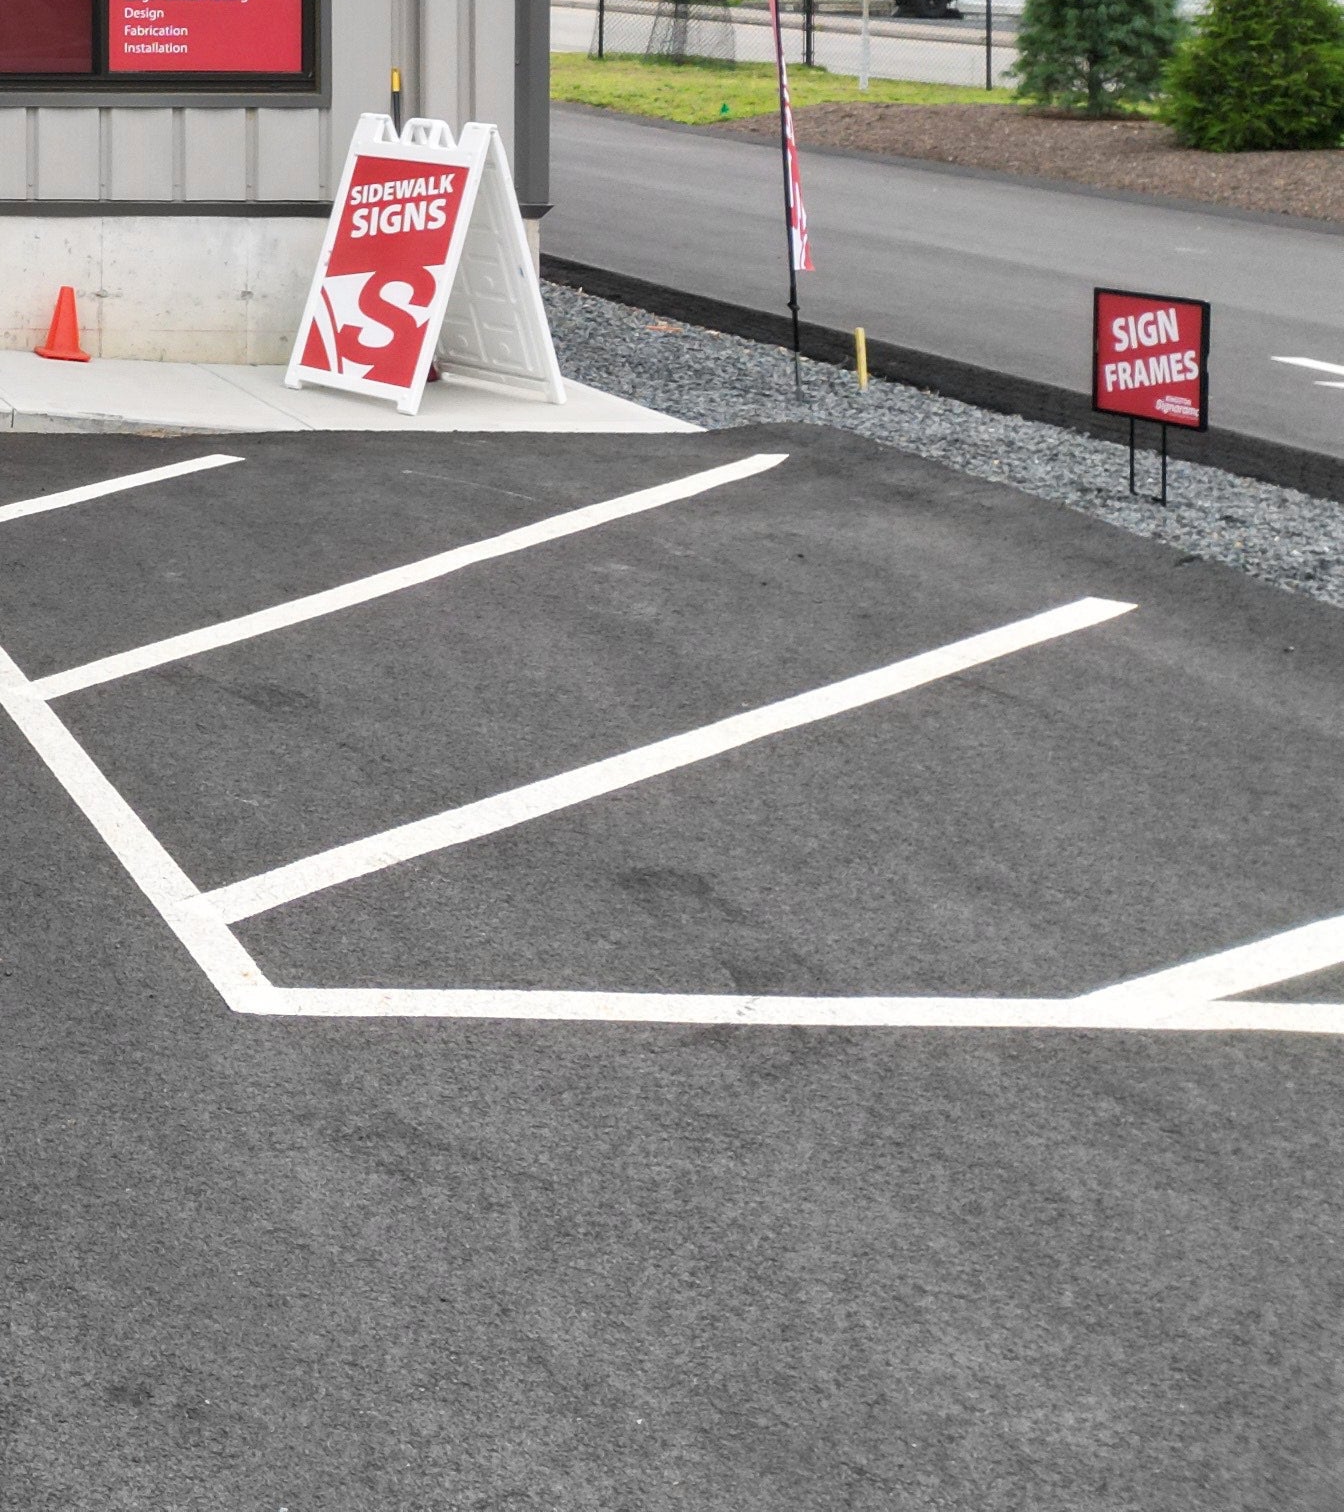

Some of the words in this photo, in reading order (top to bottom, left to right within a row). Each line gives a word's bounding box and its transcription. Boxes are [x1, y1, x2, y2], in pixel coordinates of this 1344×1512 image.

[124, 8, 164, 20] Design
[124, 25, 188, 36] Fabrication
[124, 42, 188, 53] Installation
[350, 173, 455, 206] SIDEWALK
[350, 198, 447, 239] SIGNS
[1112, 307, 1180, 352] SIGN
[1104, 350, 1200, 392] FRAMES
